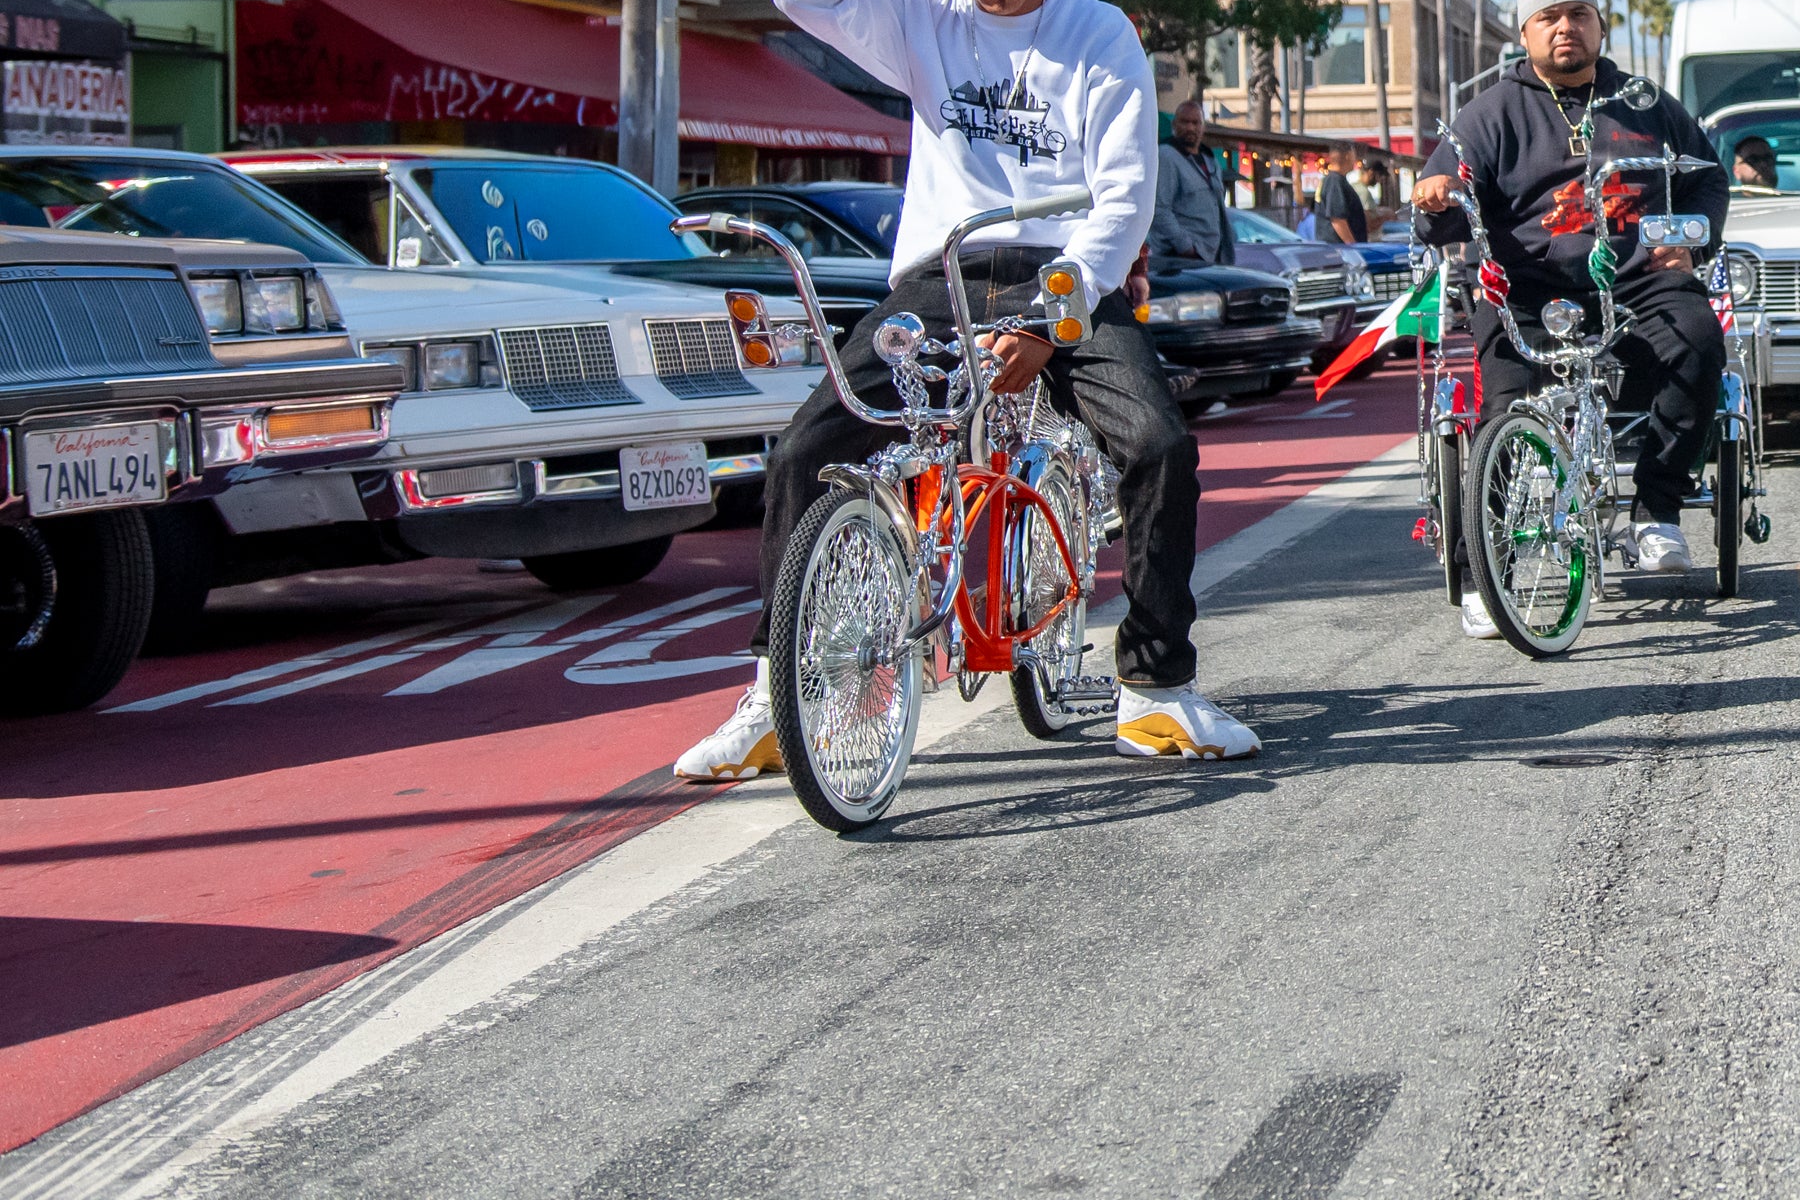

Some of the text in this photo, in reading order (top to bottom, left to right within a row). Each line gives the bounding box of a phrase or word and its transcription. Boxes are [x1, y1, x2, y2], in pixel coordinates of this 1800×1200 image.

[0, 268, 59, 279] BUICK
[55, 432, 139, 457] California
[640, 450, 691, 468] California
[37, 453, 157, 503] 7ANL494
[629, 466, 706, 500] 8ZXD693
